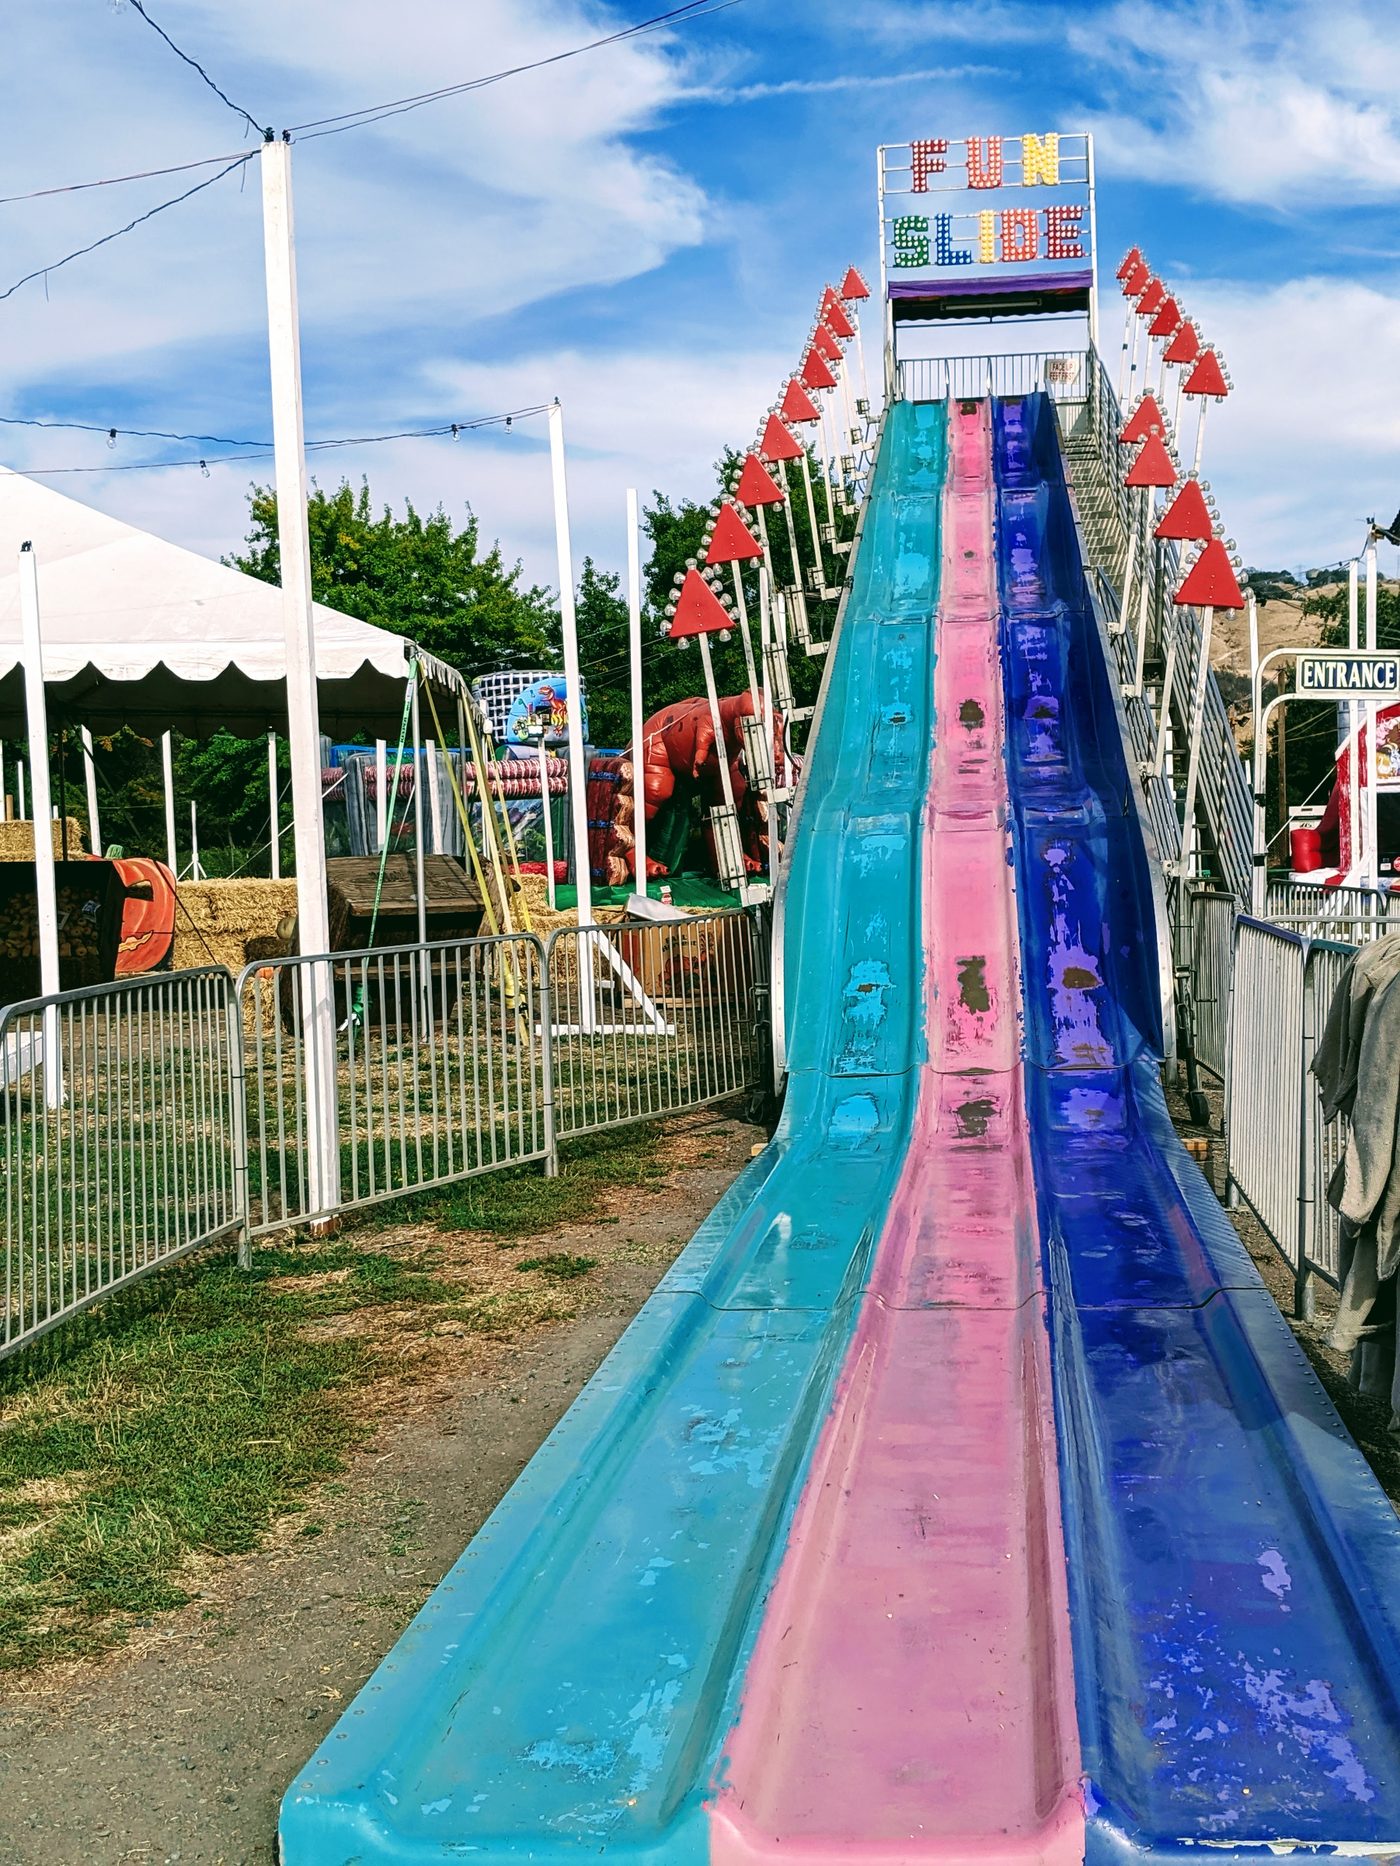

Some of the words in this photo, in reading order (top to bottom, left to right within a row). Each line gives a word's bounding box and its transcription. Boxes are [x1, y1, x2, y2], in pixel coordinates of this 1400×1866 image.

[911, 133, 1060, 193] FUN
[893, 205, 1083, 267] SLIDE
[1303, 661, 1396, 689] ENTRANCE
